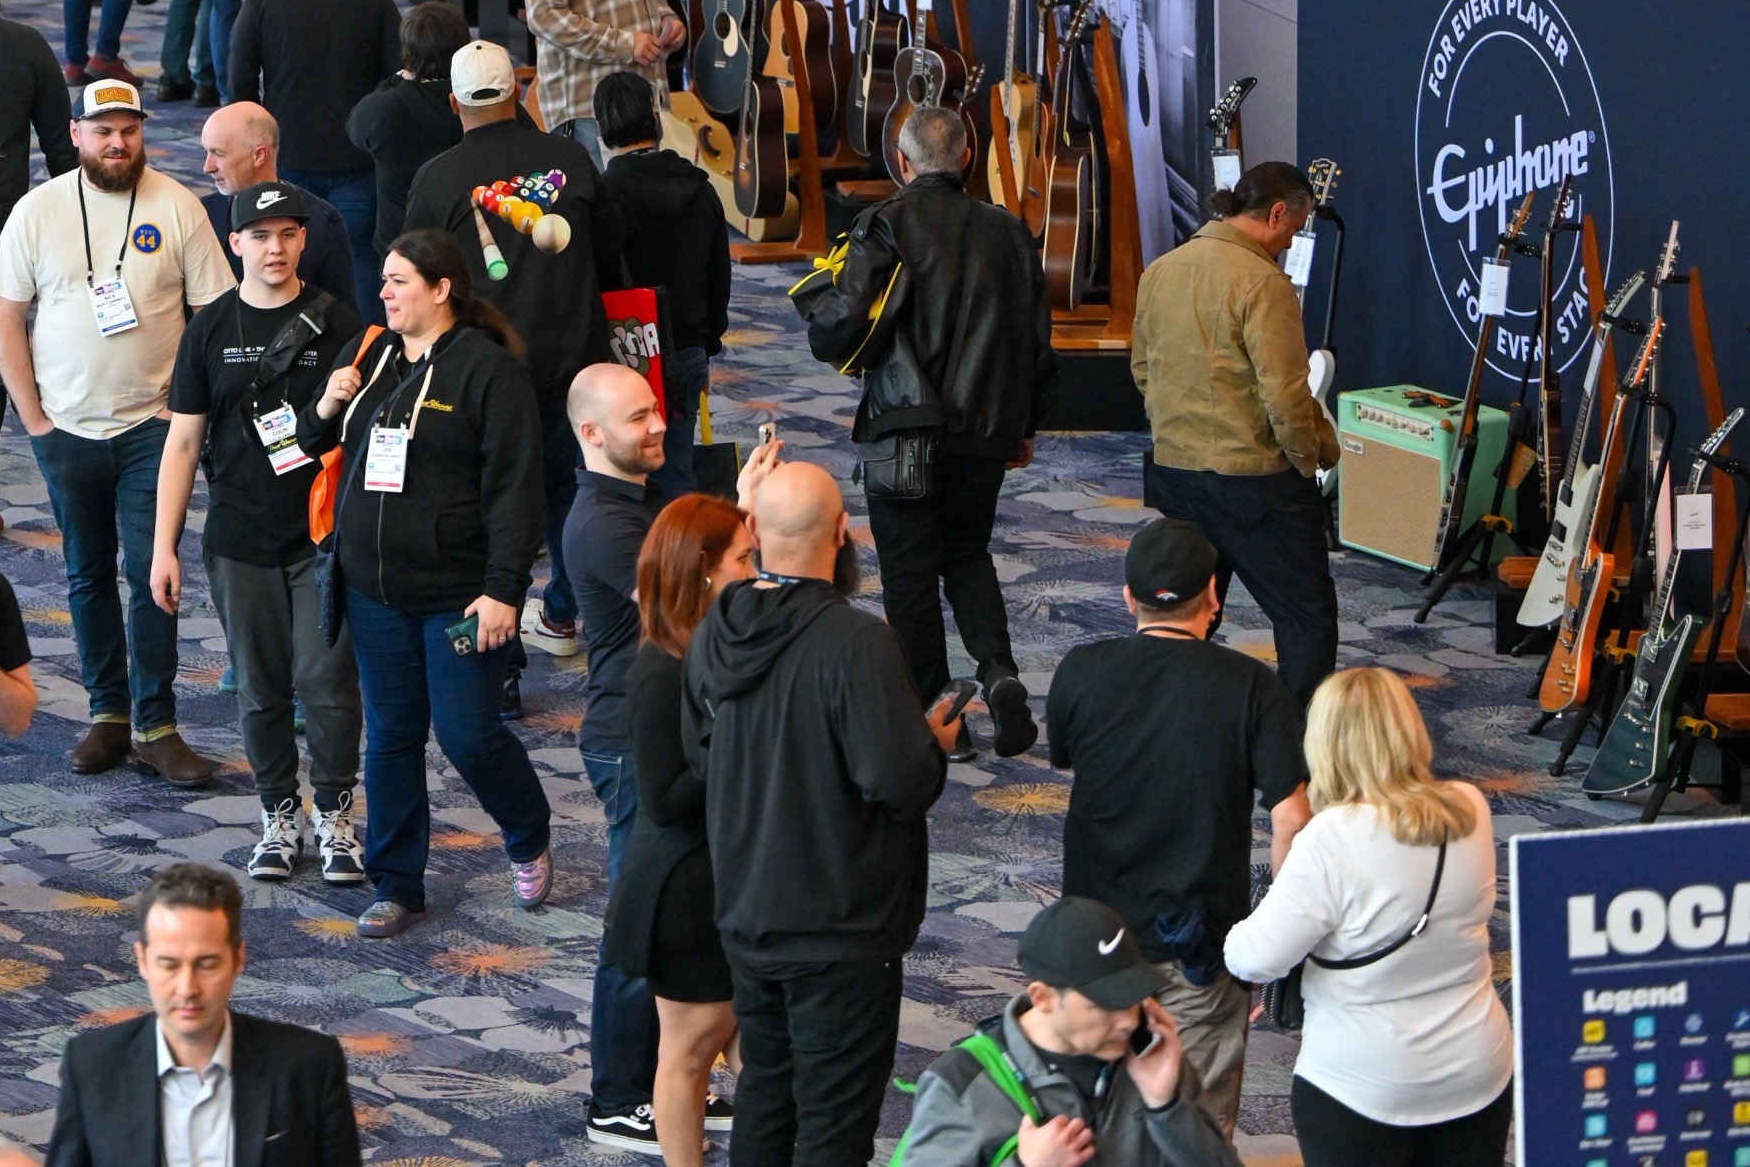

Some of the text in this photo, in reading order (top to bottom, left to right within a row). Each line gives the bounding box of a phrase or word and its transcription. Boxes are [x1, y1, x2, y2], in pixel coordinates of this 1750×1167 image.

[1428, 34, 1456, 98] FOR
[260, 190, 281, 202] NIKE
[1427, 115, 1590, 252] Epiphone
[136, 235, 155, 248] 44
[1456, 277, 1482, 324] FO
[1344, 440, 1362, 452] Boogie
[1583, 981, 1688, 1014] Legend
